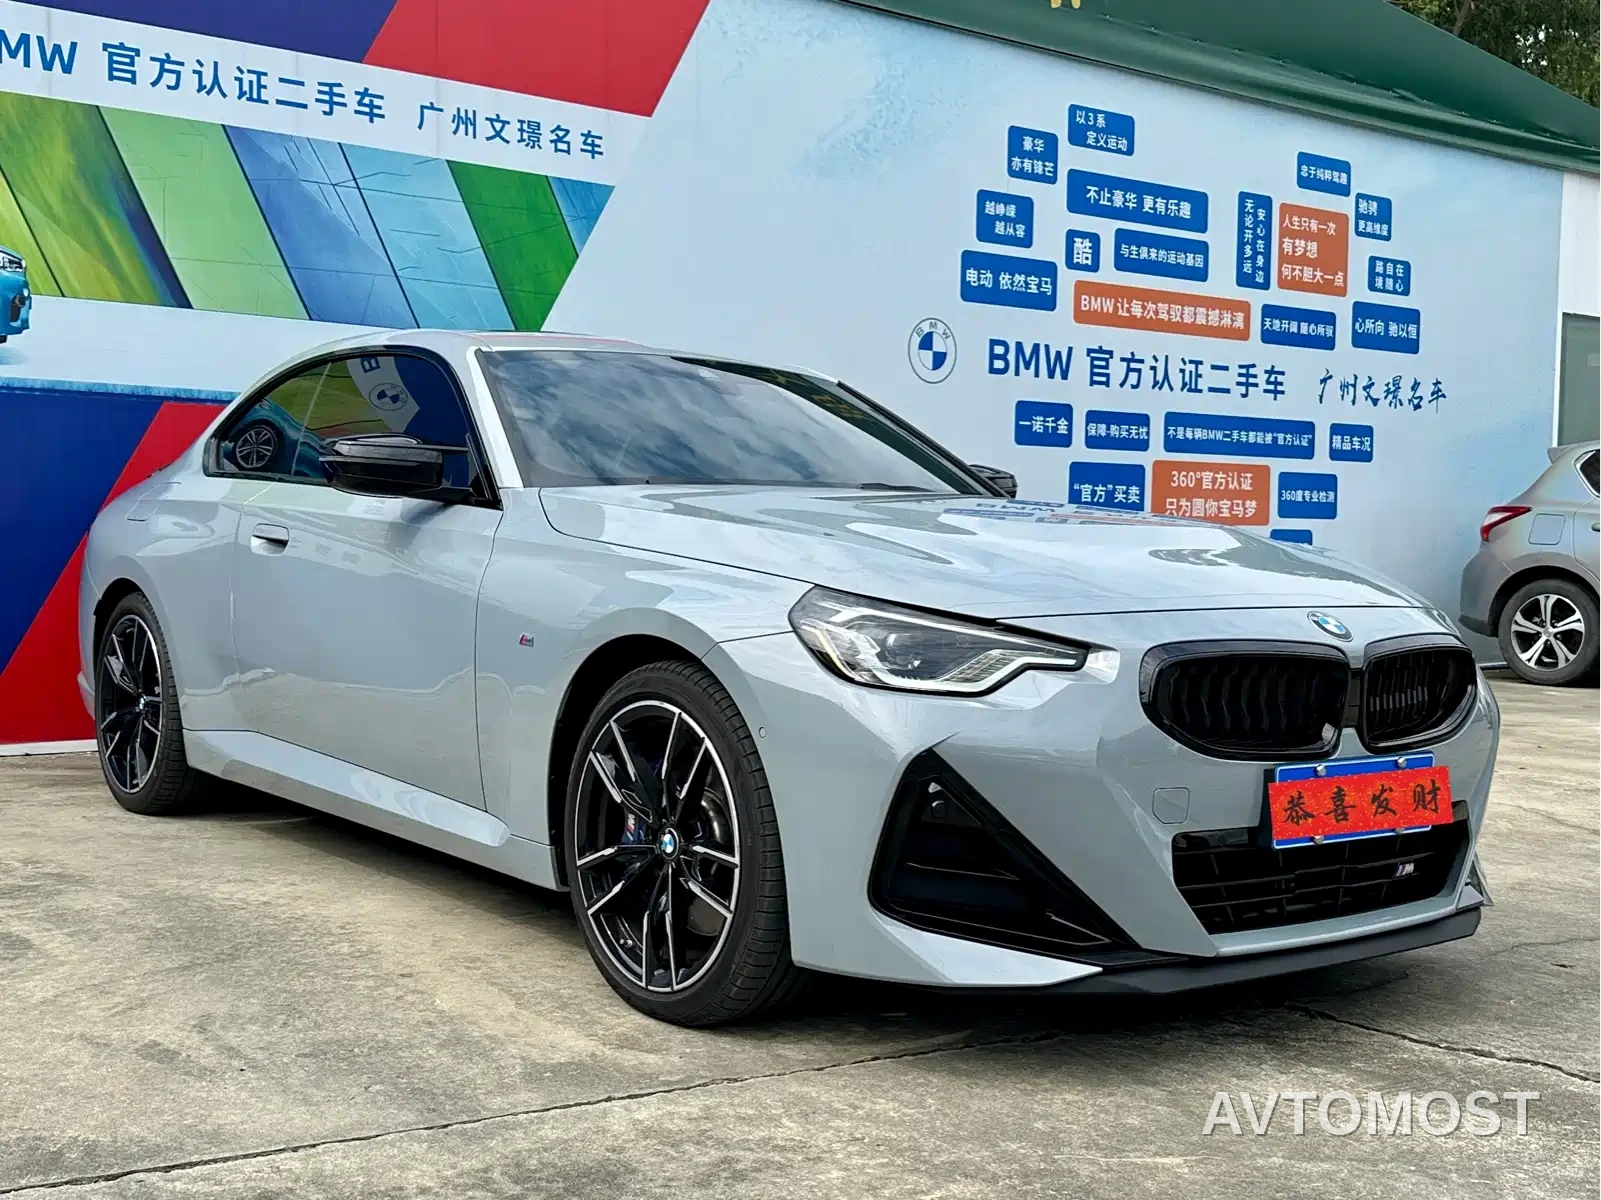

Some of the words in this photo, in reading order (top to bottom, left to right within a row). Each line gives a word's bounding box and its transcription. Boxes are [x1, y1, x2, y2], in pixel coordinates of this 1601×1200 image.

[102, 42, 385, 124] 官方认证二手车
[417, 102, 604, 159] 广州文璟名车
[1022, 136, 1045, 154] 豪华
[1086, 131, 1128, 152] 定义运动
[1011, 157, 1054, 177] 亦有锋芒
[1300, 164, 1348, 185] 忠于纯粹驾趣
[984, 200, 1017, 218] 越峥嵘
[1086, 185, 1138, 210] 不止豪华
[1142, 195, 1192, 219] 更有乐趣
[1358, 198, 1378, 216] 驰骋
[994, 221, 1026, 238] 越从容
[1282, 213, 1336, 236] 人生只有一次
[1357, 219, 1389, 236] 更高维度
[1243, 199, 1254, 274] 无论开多远
[1255, 208, 1266, 283] 安心在身边
[1282, 236, 1318, 258] 有梦想
[1072, 237, 1093, 266] 酷
[1120, 242, 1204, 268] 与生俱来的运动基因
[965, 267, 993, 288] 电动
[999, 271, 1053, 296] 依然宝马
[1281, 263, 1344, 287] 何不胆大一点
[915, 321, 951, 340] BMW
[1354, 317, 1385, 336] 心所向
[1388, 321, 1418, 339] 驰以恒
[987, 338, 1073, 380] BMW
[1086, 345, 1286, 400] 官方认证二手车
[1318, 368, 1447, 413] 广州文璟名车
[1019, 415, 1069, 435] 一诺千金
[1331, 434, 1372, 452] 精品车况
[1280, 489, 1335, 503] 360度专业检测
[1165, 497, 1257, 518] 只为圆你宝马梦
[1283, 778, 1441, 826] 恭喜发财
